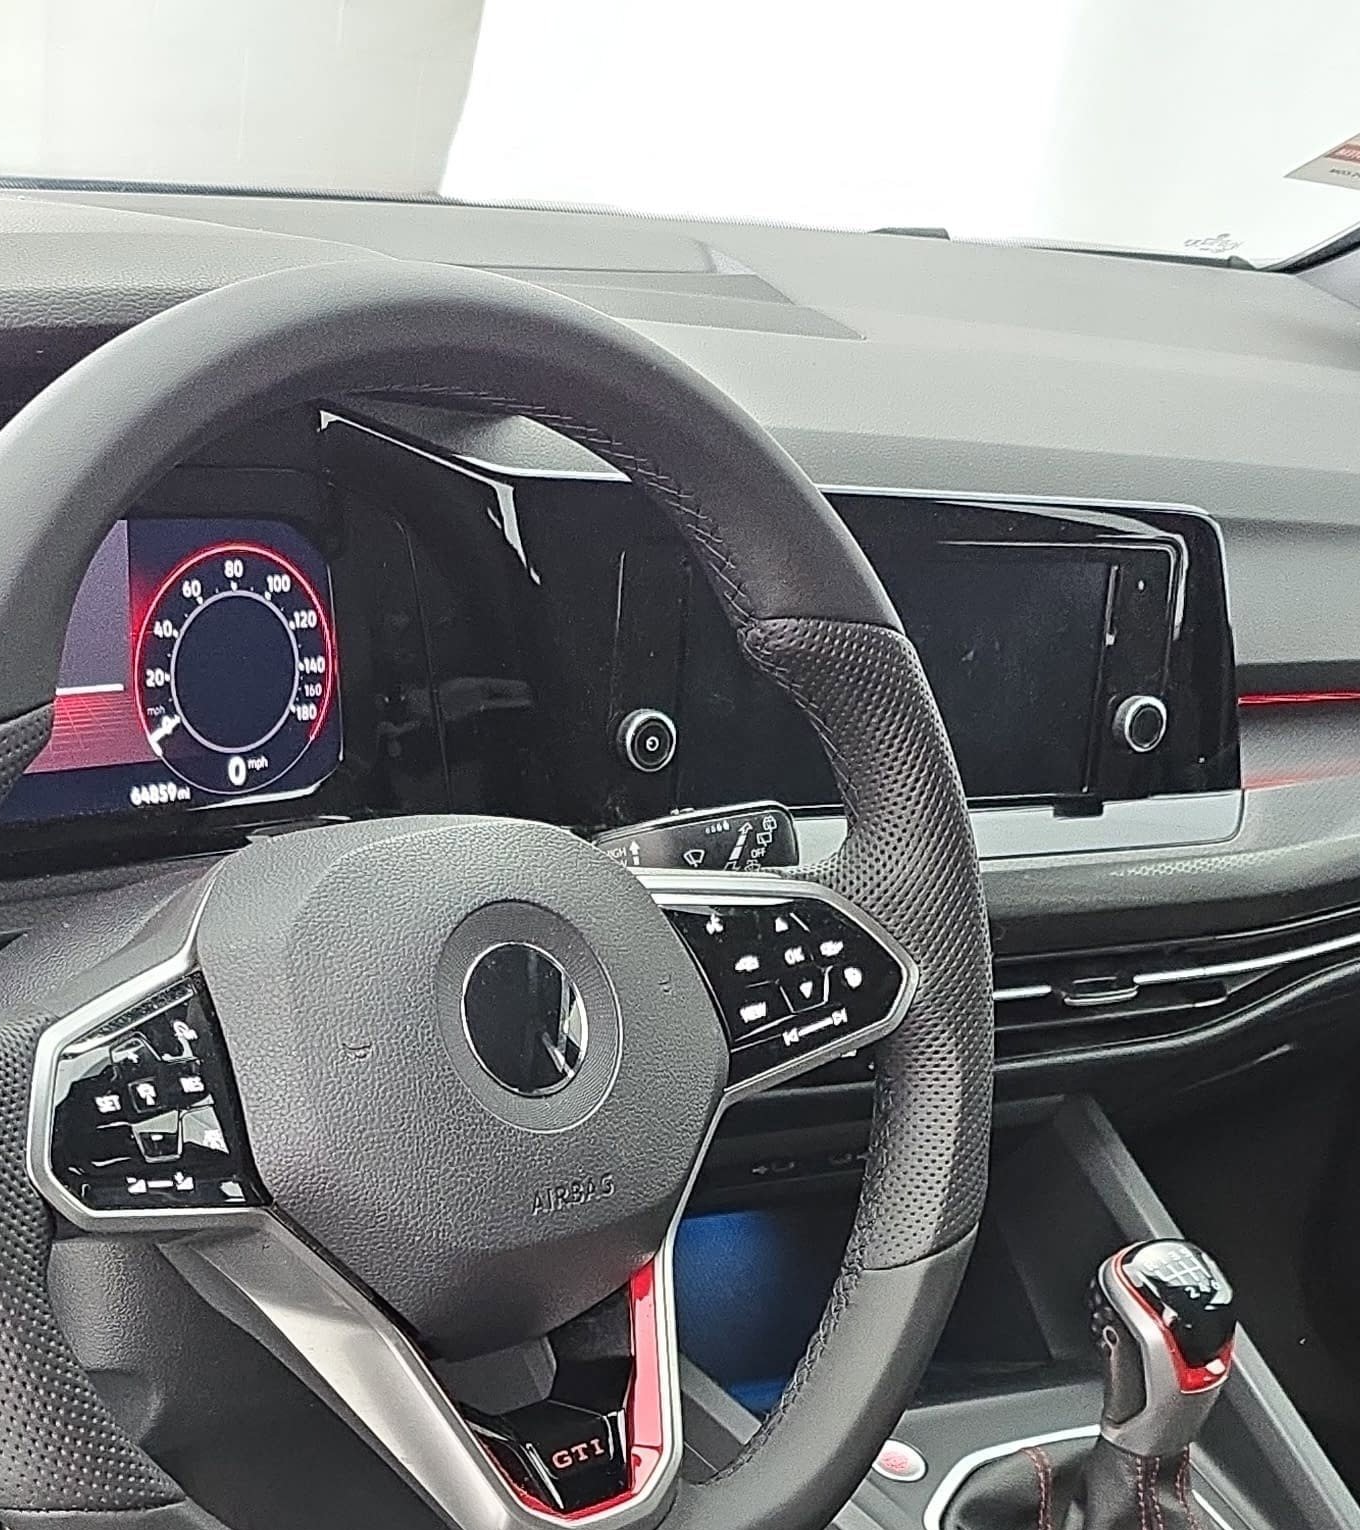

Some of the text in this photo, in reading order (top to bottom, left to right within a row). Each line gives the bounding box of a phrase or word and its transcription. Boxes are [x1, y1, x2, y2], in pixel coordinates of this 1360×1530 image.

[224, 560, 243, 577] 80
[182, 580, 201, 597] 60
[267, 575, 290, 592] 100
[293, 610, 317, 628] 120
[154, 620, 172, 638] 40
[303, 656, 325, 674] 140
[146, 668, 164, 687] 20
[304, 683, 322, 697] 160
[147, 706, 165, 716] mph
[297, 704, 317, 721] 180
[228, 756, 268, 786] 0 mph
[130, 782, 191, 806] 64859 mi
[751, 849, 766, 859] OFF
[784, 945, 805, 966] OK
[95, 1094, 121, 1113] SET
[532, 1172, 615, 1216] AIRBAG
[1184, 1286, 1200, 1299] 2
[552, 1438, 605, 1469] GTI
